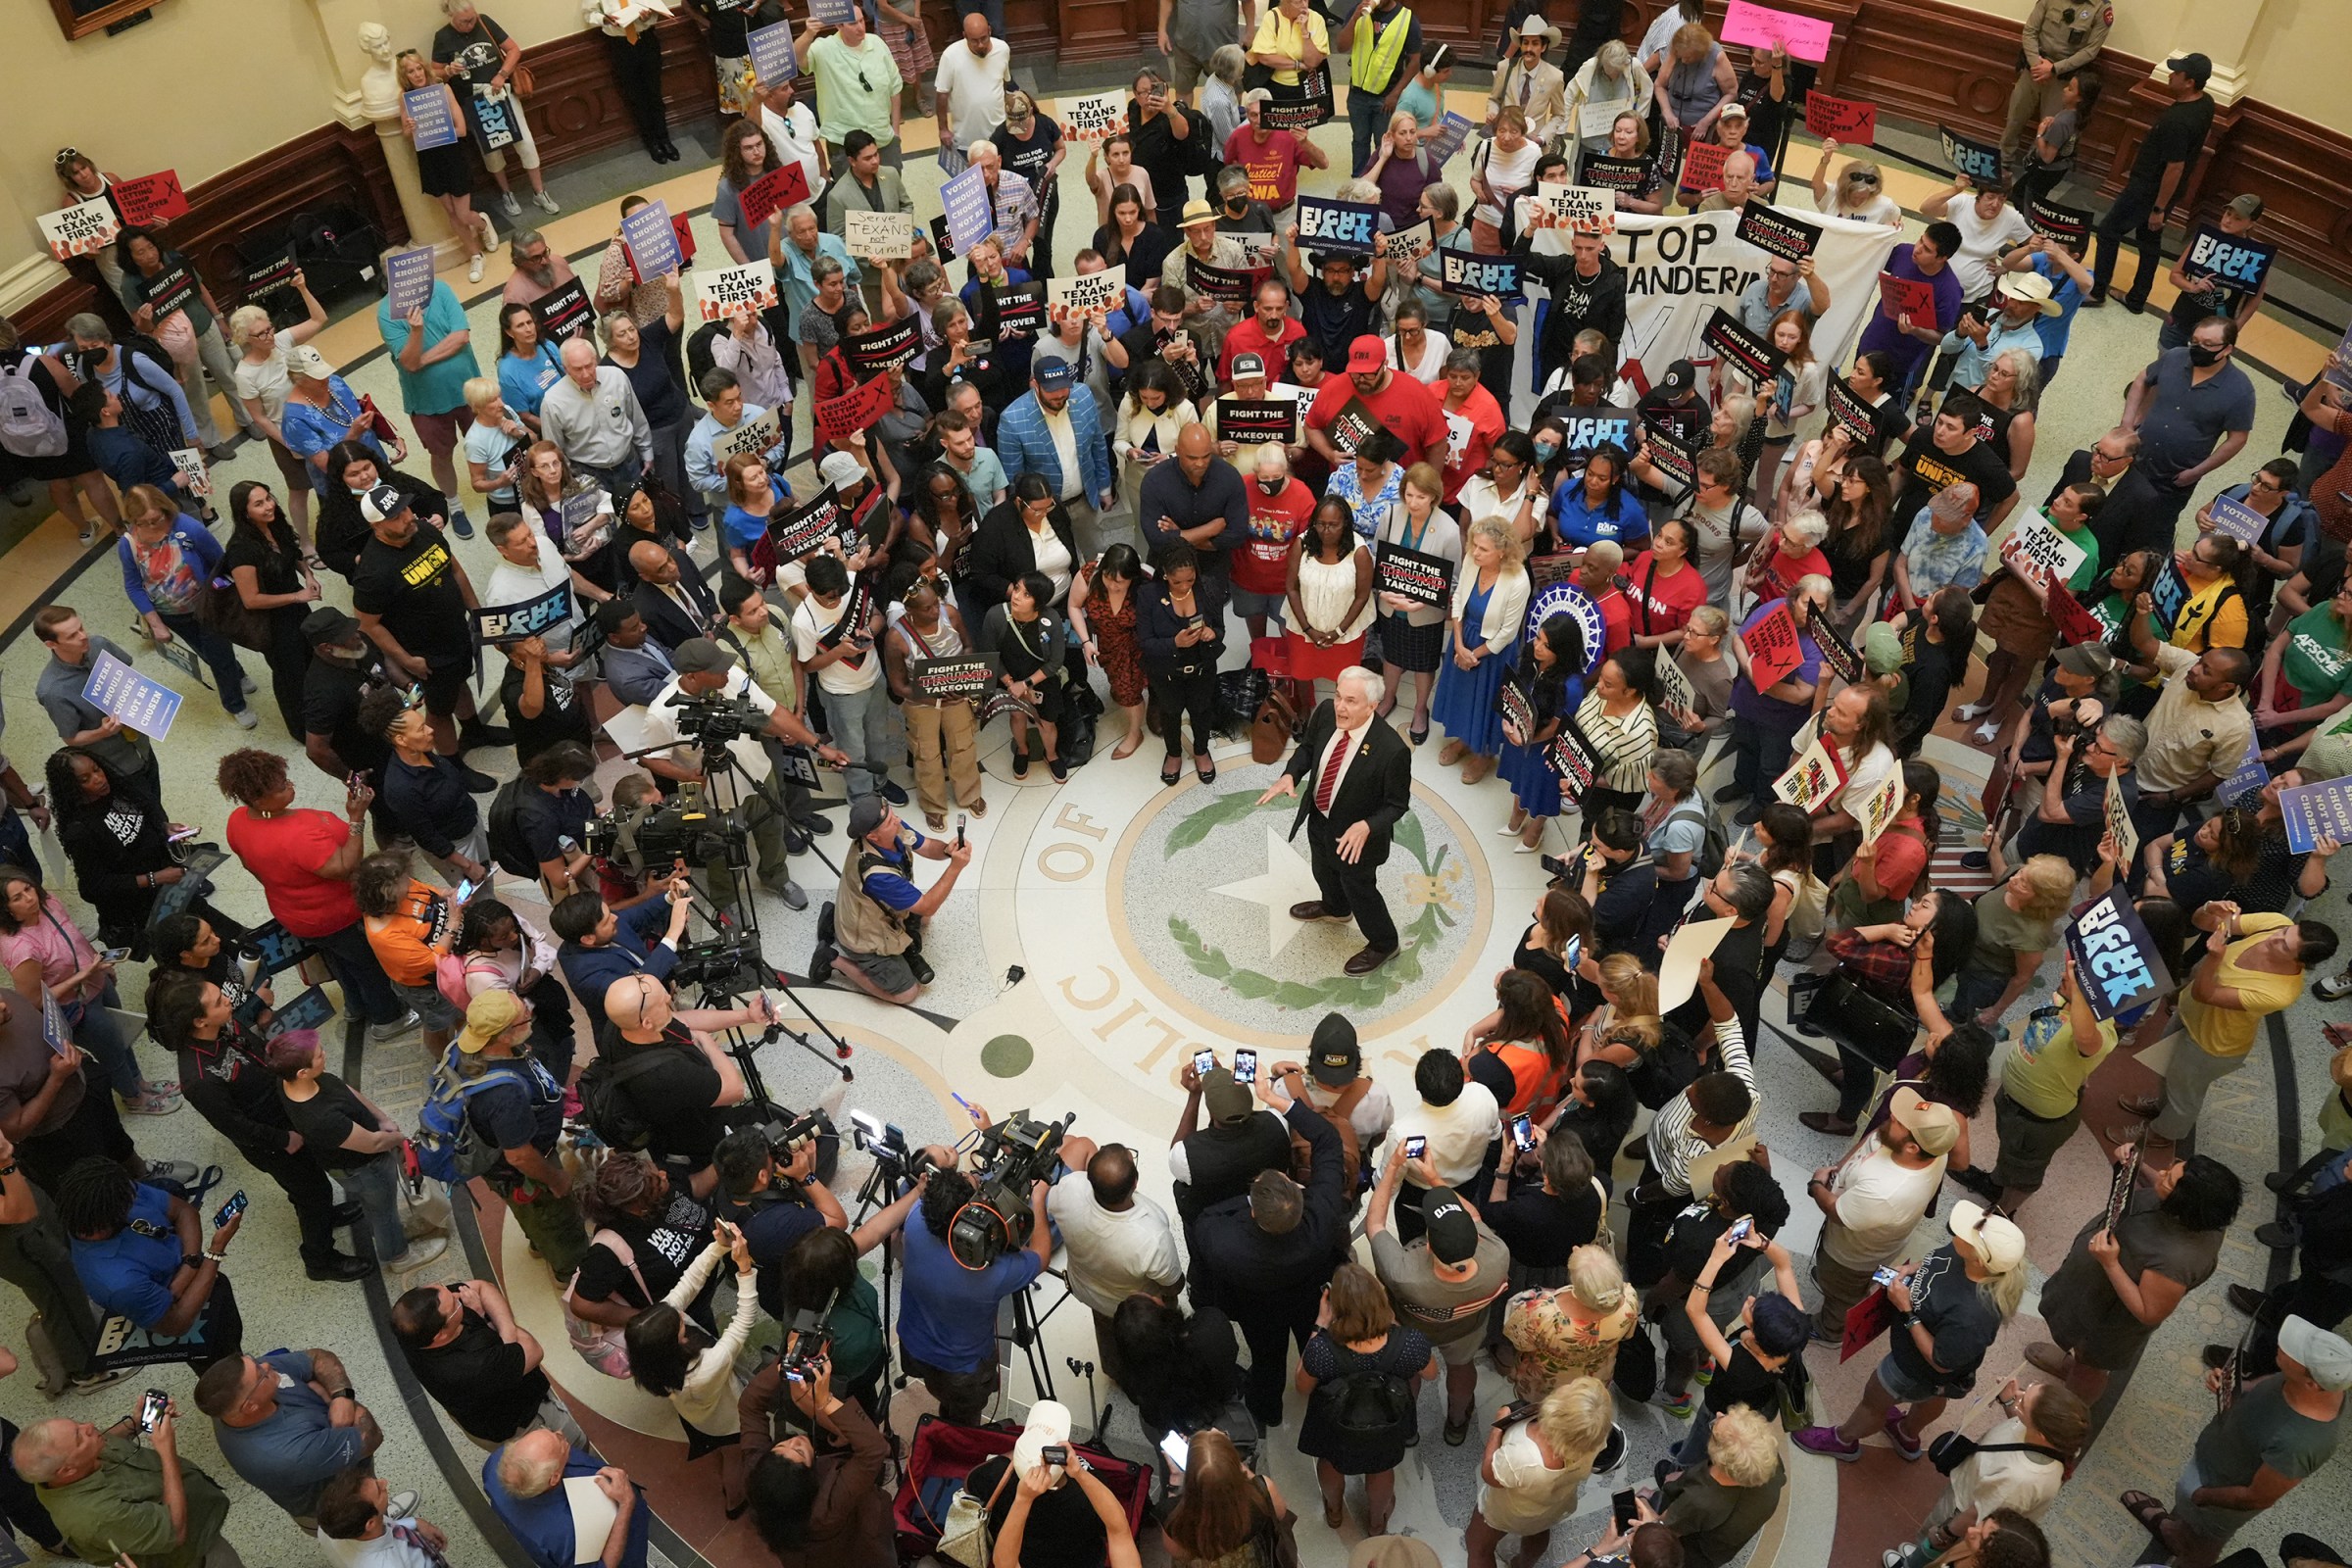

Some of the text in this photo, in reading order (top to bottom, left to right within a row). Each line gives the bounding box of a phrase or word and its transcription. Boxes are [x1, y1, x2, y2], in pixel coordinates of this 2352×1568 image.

[753, 27, 784, 43] VOTERS
[755, 37, 787, 51] SHOULD
[762, 60, 779, 71] NOT
[762, 64, 791, 81] CHOSEN
[410, 90, 440, 102] VOTERS
[413, 100, 442, 112] SHOULD
[1078, 99, 1102, 110] PUT
[1068, 105, 1117, 120] TEXANS
[1298, 104, 1317, 113] THE
[418, 120, 433, 129] NOT
[418, 126, 448, 138] CHOSEN
[1077, 117, 1110, 128] FIRST
[1271, 117, 1318, 129] TAKEOVER
[1012, 152, 1049, 167] DEMOCRACY
[1016, 148, 1043, 161] VETS FOR
[1594, 162, 1617, 172] FIGHT
[1690, 161, 1719, 173] TRUMP
[946, 174, 978, 196] VOTERS
[1563, 189, 1589, 200] PUT
[1590, 179, 1638, 190] TAKEOVER
[122, 196, 150, 208] TRUMP
[950, 184, 981, 208] SHOULD
[1550, 198, 1603, 211] TEXANS
[54, 212, 104, 235] TEXANS
[62, 208, 85, 223] PUT
[628, 207, 661, 230] VOTERS
[957, 207, 985, 230] NOT BE
[1301, 206, 1372, 228] FIGHT
[1558, 209, 1595, 220] FIRST
[2032, 201, 2080, 225] FIGHT THE
[66, 224, 99, 242] FIRST
[632, 219, 664, 240] SHOULD
[850, 223, 909, 237] TEXANS
[958, 217, 989, 241] CHOSEN
[1300, 218, 1373, 244] BACK
[1754, 212, 1806, 241] FIGHT THE
[641, 240, 671, 260] NOT BE
[852, 243, 909, 255] TRUMP
[870, 235, 886, 245] not
[1746, 230, 1800, 261] TAKEOVER
[2195, 233, 2266, 267] FIGHT
[393, 253, 428, 267] VOTERS
[643, 248, 676, 269] CHOSEN
[1444, 256, 1516, 278] FIGHT
[2190, 245, 2263, 284] BACK
[249, 266, 273, 282] FIGHT
[394, 264, 429, 278] SHOULD
[394, 274, 431, 289] CHOOSE,
[720, 270, 747, 283] PUT
[1446, 267, 1519, 293] BACK
[149, 278, 170, 296] FIGHT
[398, 288, 417, 298] NOT
[708, 276, 763, 294] TEXANS
[1061, 282, 1115, 300] TEXANS
[1076, 276, 1102, 289] PUT
[155, 288, 192, 316] TAKEOVER
[544, 290, 581, 316] FIGHT THE
[719, 288, 757, 304] FIRST
[1070, 295, 1108, 308] FIRST
[555, 311, 590, 337] TAKEOVER
[860, 327, 912, 351] FIGHT THE
[1721, 322, 1771, 365] FIGHT THE
[1354, 351, 1370, 360] CWA
[1713, 339, 1761, 380] TAKEOVER
[1044, 370, 1067, 379] TEXAS
[1229, 409, 1284, 419] FIGHT THE
[1833, 384, 1871, 422] FIGHT THE
[824, 411, 858, 424] TRUMP
[735, 422, 759, 441] PUT
[1229, 431, 1284, 441] TAKEOVER
[1652, 432, 1688, 460] FIGHT THE
[1653, 455, 1692, 483] TAKEOVER
[783, 499, 832, 535] FIGHT THE
[2215, 515, 2252, 539] SHOULD
[2222, 503, 2259, 529] VOTERS
[789, 522, 838, 556] TAKEOVER
[841, 529, 858, 541] WE
[2039, 525, 2064, 549] PUT
[2023, 541, 2055, 571] FIRST
[2025, 527, 2068, 568] TEXANS
[403, 547, 449, 585] UNION
[1379, 561, 1446, 589] TRUMP
[1388, 554, 1441, 578] FIGHT THE
[1384, 577, 1438, 601] TAKEOVER
[1626, 583, 1667, 615] UNON
[482, 591, 565, 625] FIGHT
[482, 601, 569, 638] BACK
[1777, 610, 1793, 647] ABBOTT'S
[1764, 618, 1777, 647] TRUMP
[1770, 615, 1786, 648] LETTING
[1748, 632, 1761, 660] TEXAS
[1757, 625, 1773, 667] TAKE OVER
[1834, 642, 1853, 663] THE
[2294, 633, 2345, 675] AFSCME
[917, 668, 993, 688] TRUMP
[927, 662, 985, 675] FIGHT THE
[1667, 664, 1684, 686] PUT
[91, 661, 113, 699] VOTERS
[101, 669, 124, 706] SHOULD
[925, 682, 984, 694] TAKEOVER
[1660, 664, 1688, 706] TEXANS
[113, 677, 139, 715] CHOOSE,
[126, 686, 149, 719] NOT BE
[1509, 681, 1525, 704] FIGHT
[140, 690, 163, 727] CHOSEN
[1556, 734, 1593, 789] TRUMP
[1564, 730, 1594, 772] FIGHT THE
[1554, 752, 1583, 796] TAKEOVER
[2225, 770, 2258, 789] NOT BE
[2315, 794, 2336, 837] NOT BE
[117, 820, 132, 841] NOT
[122, 832, 136, 846] FOR
[1038, 802, 1109, 882] OF
[2094, 897, 2156, 991] FIGHT
[2078, 913, 2138, 1008] BACK
[1434, 1203, 1463, 1219] BETO
[648, 1227, 670, 1248] WE
[658, 1232, 675, 1255] FOR
[665, 1237, 684, 1261] NOT
[672, 1250, 688, 1267] FOR
[96, 1318, 206, 1356] BACK
[106, 1351, 189, 1367] DALLASDEMOCRATS.ORG
